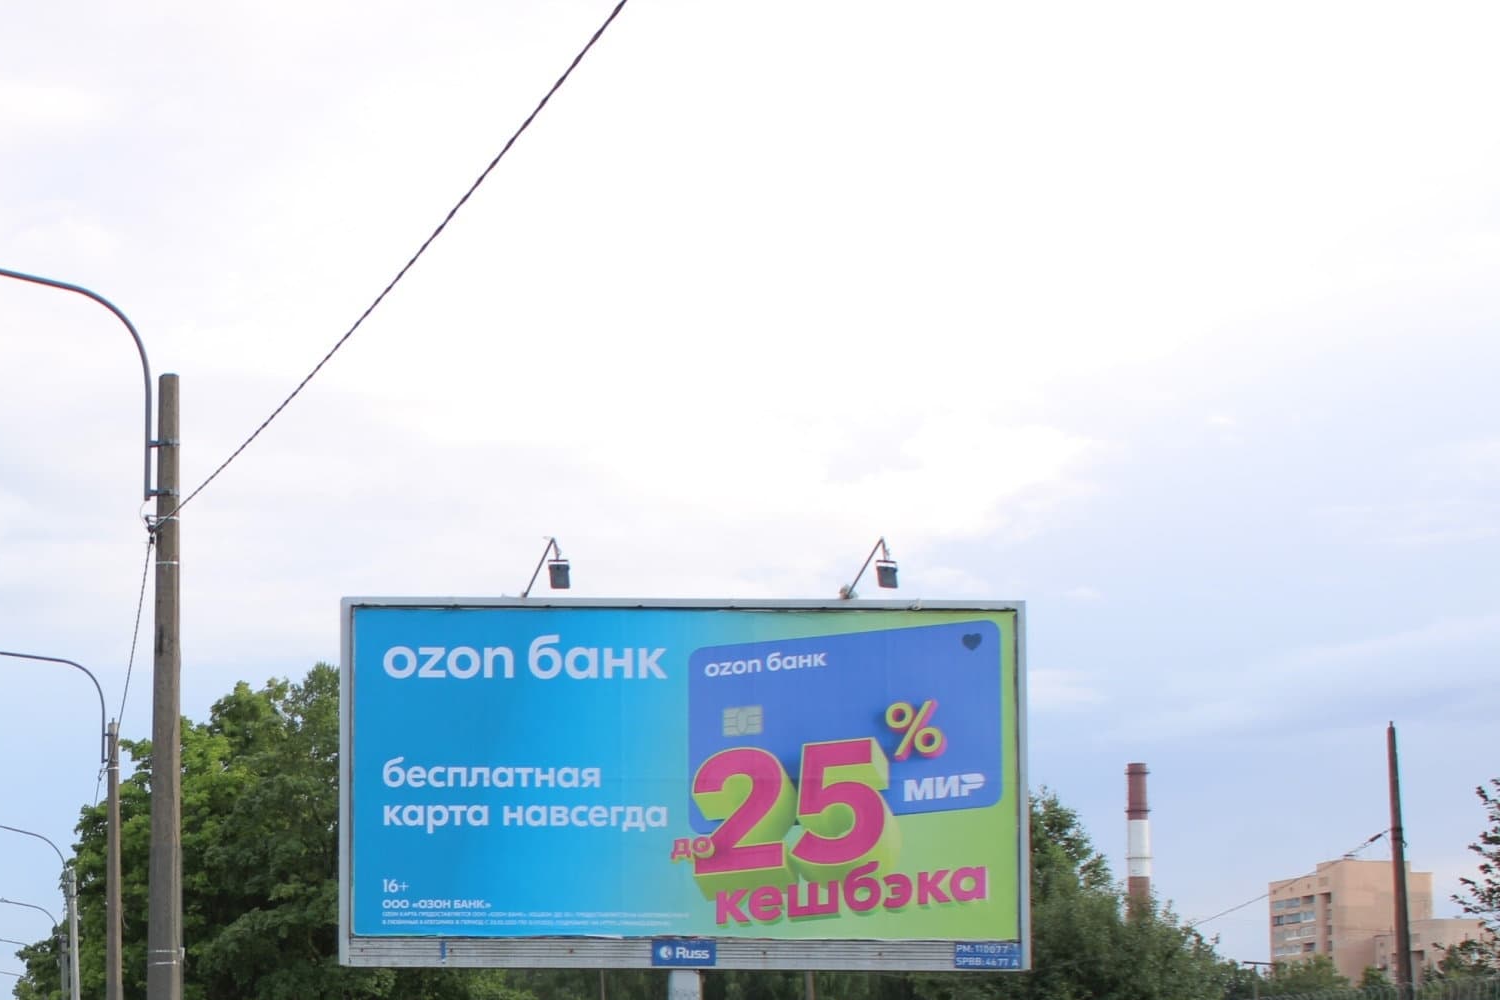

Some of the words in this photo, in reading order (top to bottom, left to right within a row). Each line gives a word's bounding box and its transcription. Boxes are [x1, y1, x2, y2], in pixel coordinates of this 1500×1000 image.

[383, 645, 514, 679] ozon
[528, 634, 668, 680] банк
[704, 656, 762, 678] ozon
[766, 651, 828, 672] банк
[383, 756, 601, 788] бесплатная
[903, 773, 986, 802] МИР
[383, 804, 489, 834] карта
[503, 805, 668, 832] навсегда
[671, 837, 713, 862] до
[383, 879, 409, 893] 16+
[715, 861, 988, 925] кешбэка
[382, 899, 409, 909] ООО
[675, 946, 710, 959] Russ
